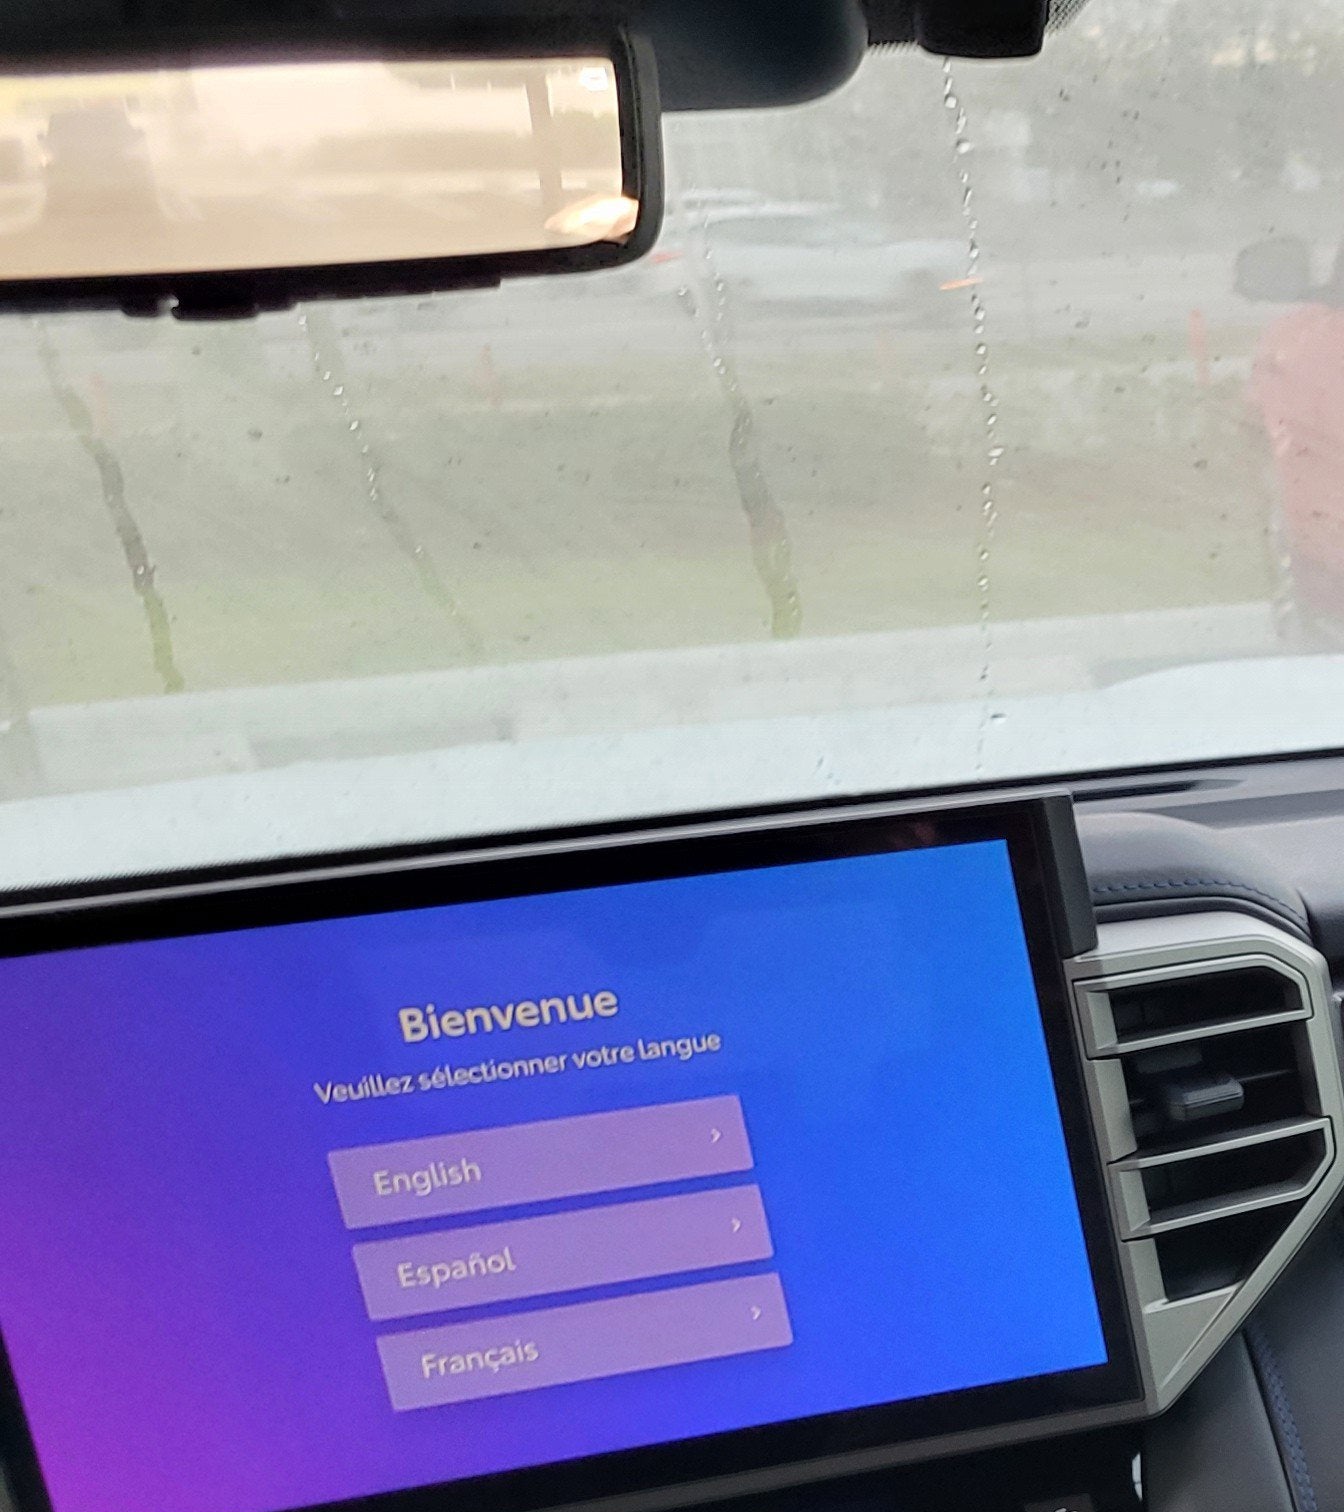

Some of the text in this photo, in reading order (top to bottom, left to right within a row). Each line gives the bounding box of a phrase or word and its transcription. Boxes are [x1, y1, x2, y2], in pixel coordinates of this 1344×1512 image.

[399, 990, 618, 1042] Bienvenue
[313, 1032, 721, 1104] Veuillez sélectionner votre langue
[373, 1158, 481, 1196] English
[397, 1246, 517, 1288] Español
[421, 1340, 539, 1378] Français
